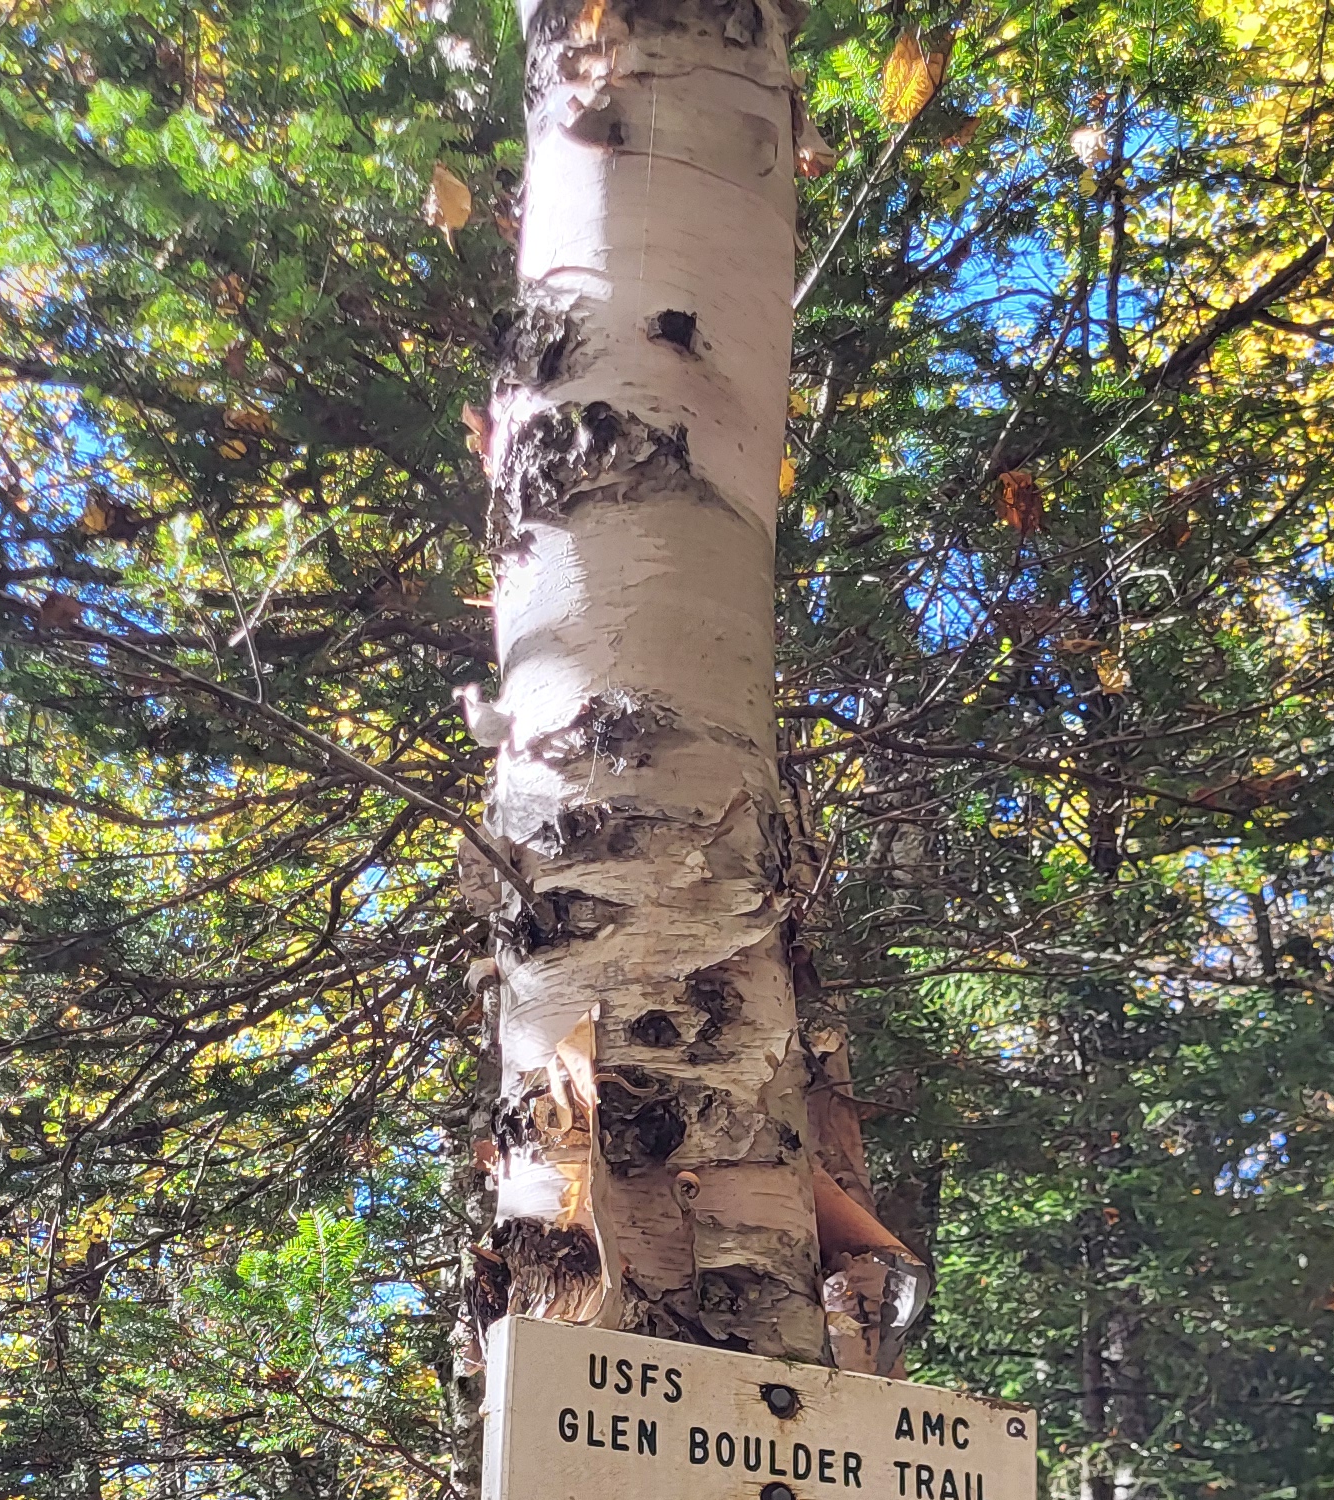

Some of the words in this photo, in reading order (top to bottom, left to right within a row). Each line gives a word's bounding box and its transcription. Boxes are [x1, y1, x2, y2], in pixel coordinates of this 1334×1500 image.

[588, 1353, 683, 1403] USFS
[558, 1407, 658, 1457] GLEN
[688, 1426, 863, 1489] BOULDER
[894, 1406, 971, 1451] AMC
